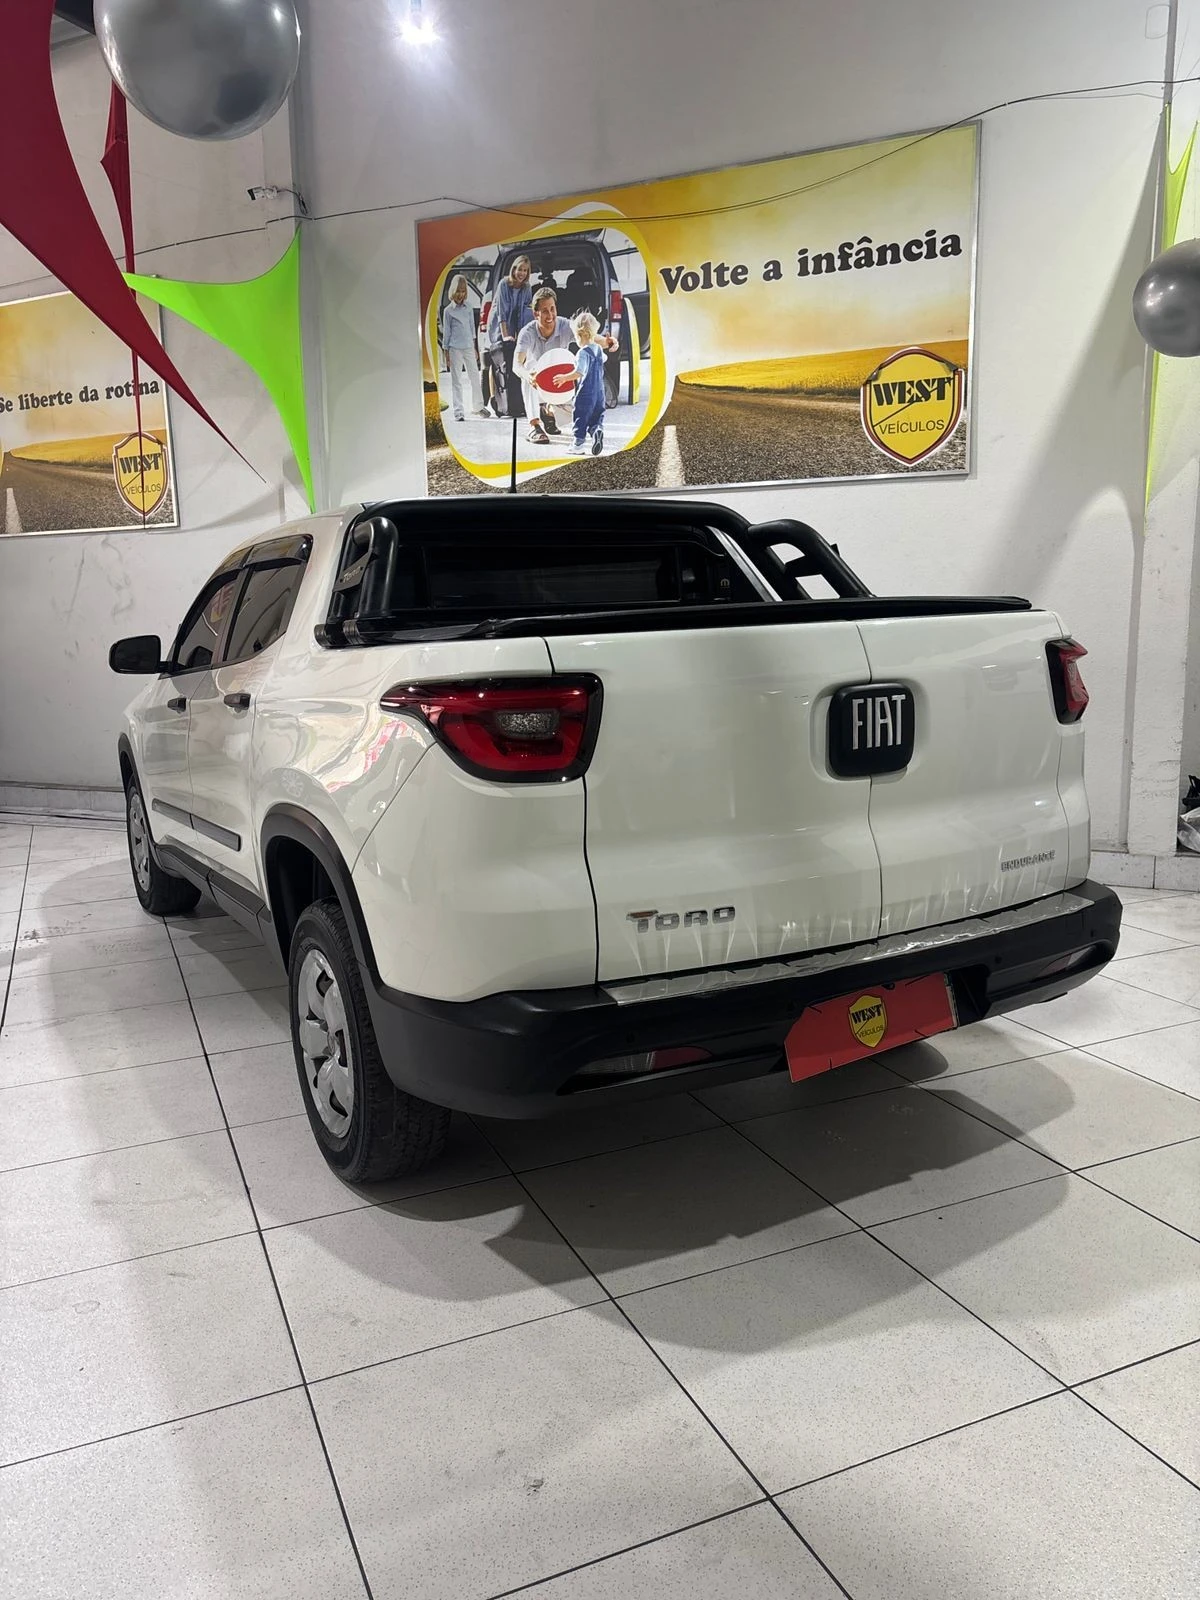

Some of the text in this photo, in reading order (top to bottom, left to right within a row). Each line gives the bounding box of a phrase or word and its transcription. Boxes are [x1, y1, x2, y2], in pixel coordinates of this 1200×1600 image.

[660, 229, 963, 295] Volte a infância
[18, 390, 73, 411] liberte
[79, 385, 99, 403] da
[873, 377, 952, 406] WEST
[879, 420, 945, 435] VEÍCULOS
[119, 453, 162, 474] WEST
[852, 694, 906, 751] FIAT
[1001, 849, 1056, 872] ENDURANCE
[851, 1003, 882, 1024] WEST
